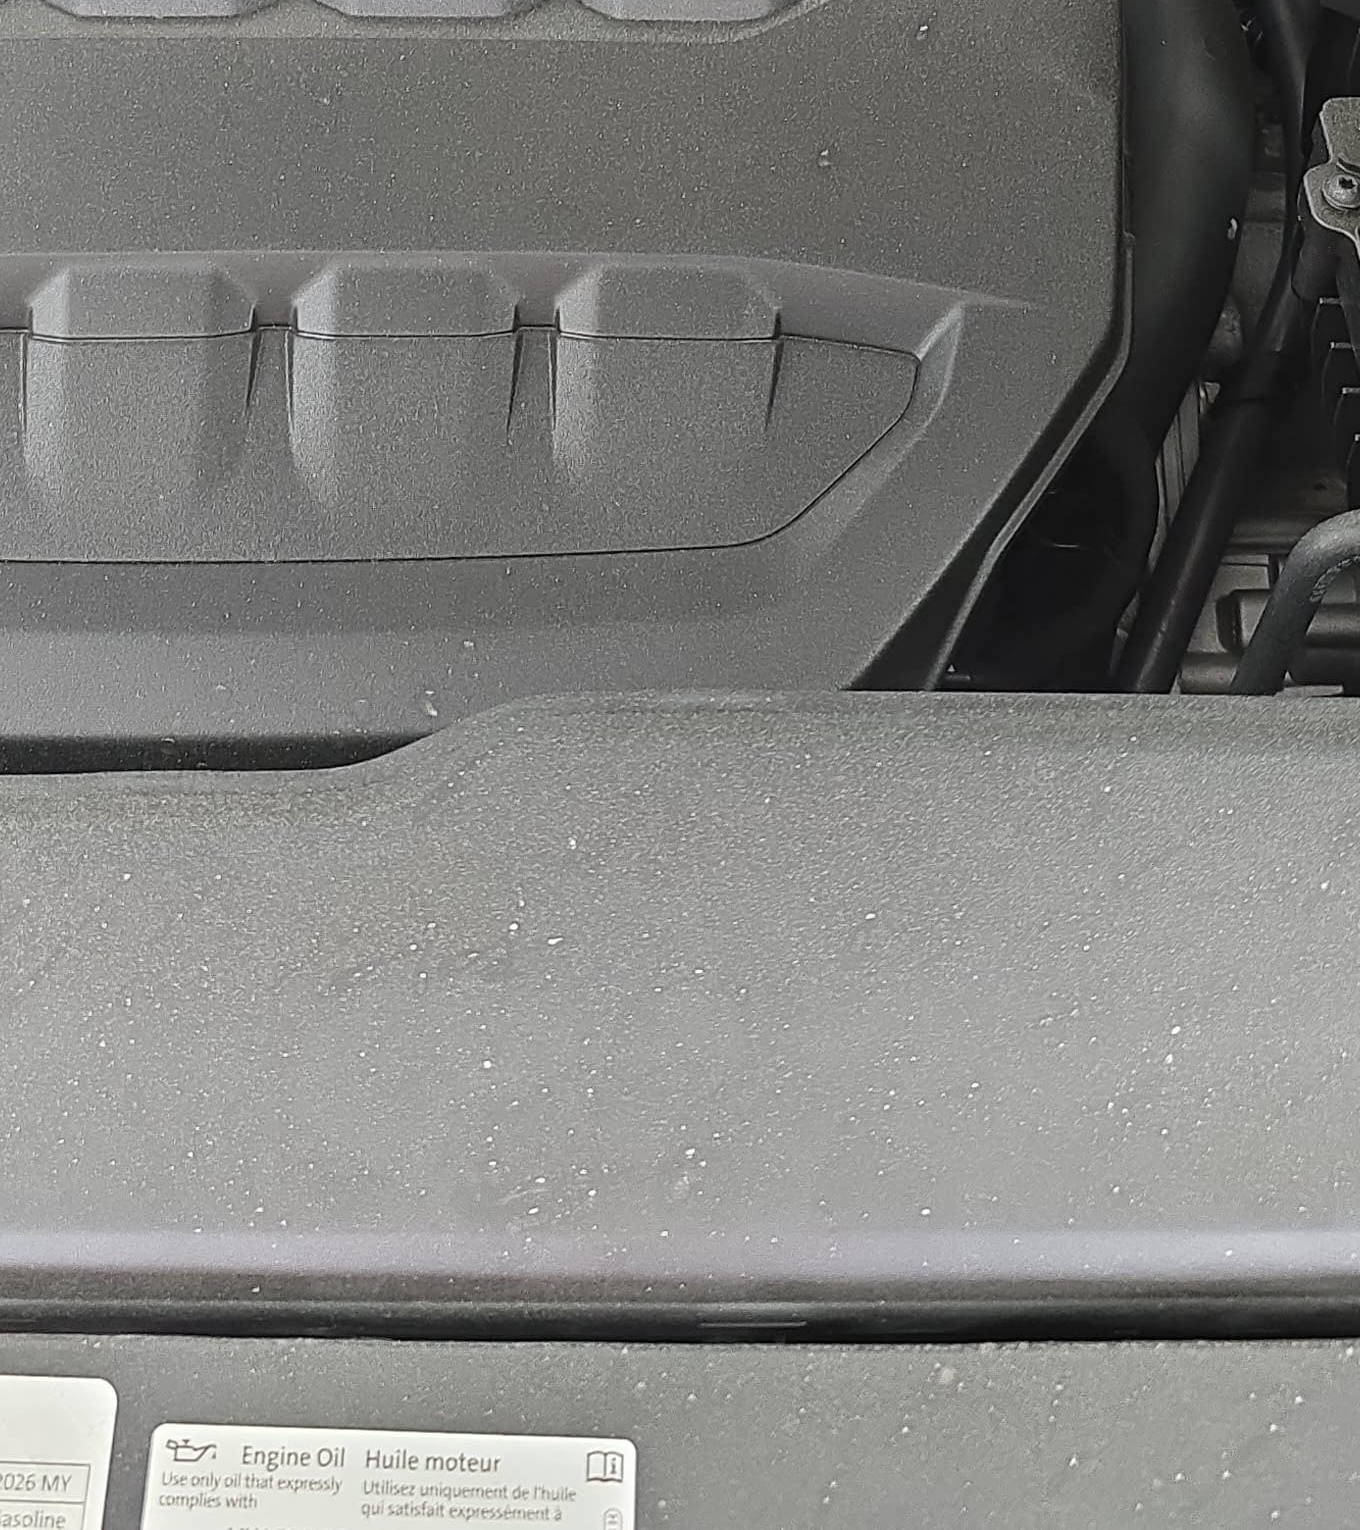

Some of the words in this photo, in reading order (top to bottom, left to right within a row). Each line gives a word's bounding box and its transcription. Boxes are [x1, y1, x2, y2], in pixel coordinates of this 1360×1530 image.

[241, 1445, 311, 1472] Engine
[317, 1447, 346, 1468] Oil
[366, 1449, 420, 1470] Huile
[425, 1453, 501, 1473] moteur
[41, 1474, 73, 1493] MY
[161, 1471, 188, 1488] Use
[190, 1472, 221, 1492] only
[224, 1473, 241, 1489] oil
[244, 1474, 274, 1490] that
[277, 1476, 344, 1496] expressly
[363, 1480, 415, 1498] Utilisez
[420, 1482, 508, 1501] uniquement
[512, 1485, 530, 1500] de
[158, 1493, 222, 1511] complies
[225, 1494, 258, 1509] with
[361, 1502, 385, 1520] qui
[387, 1501, 445, 1519] satisfait
